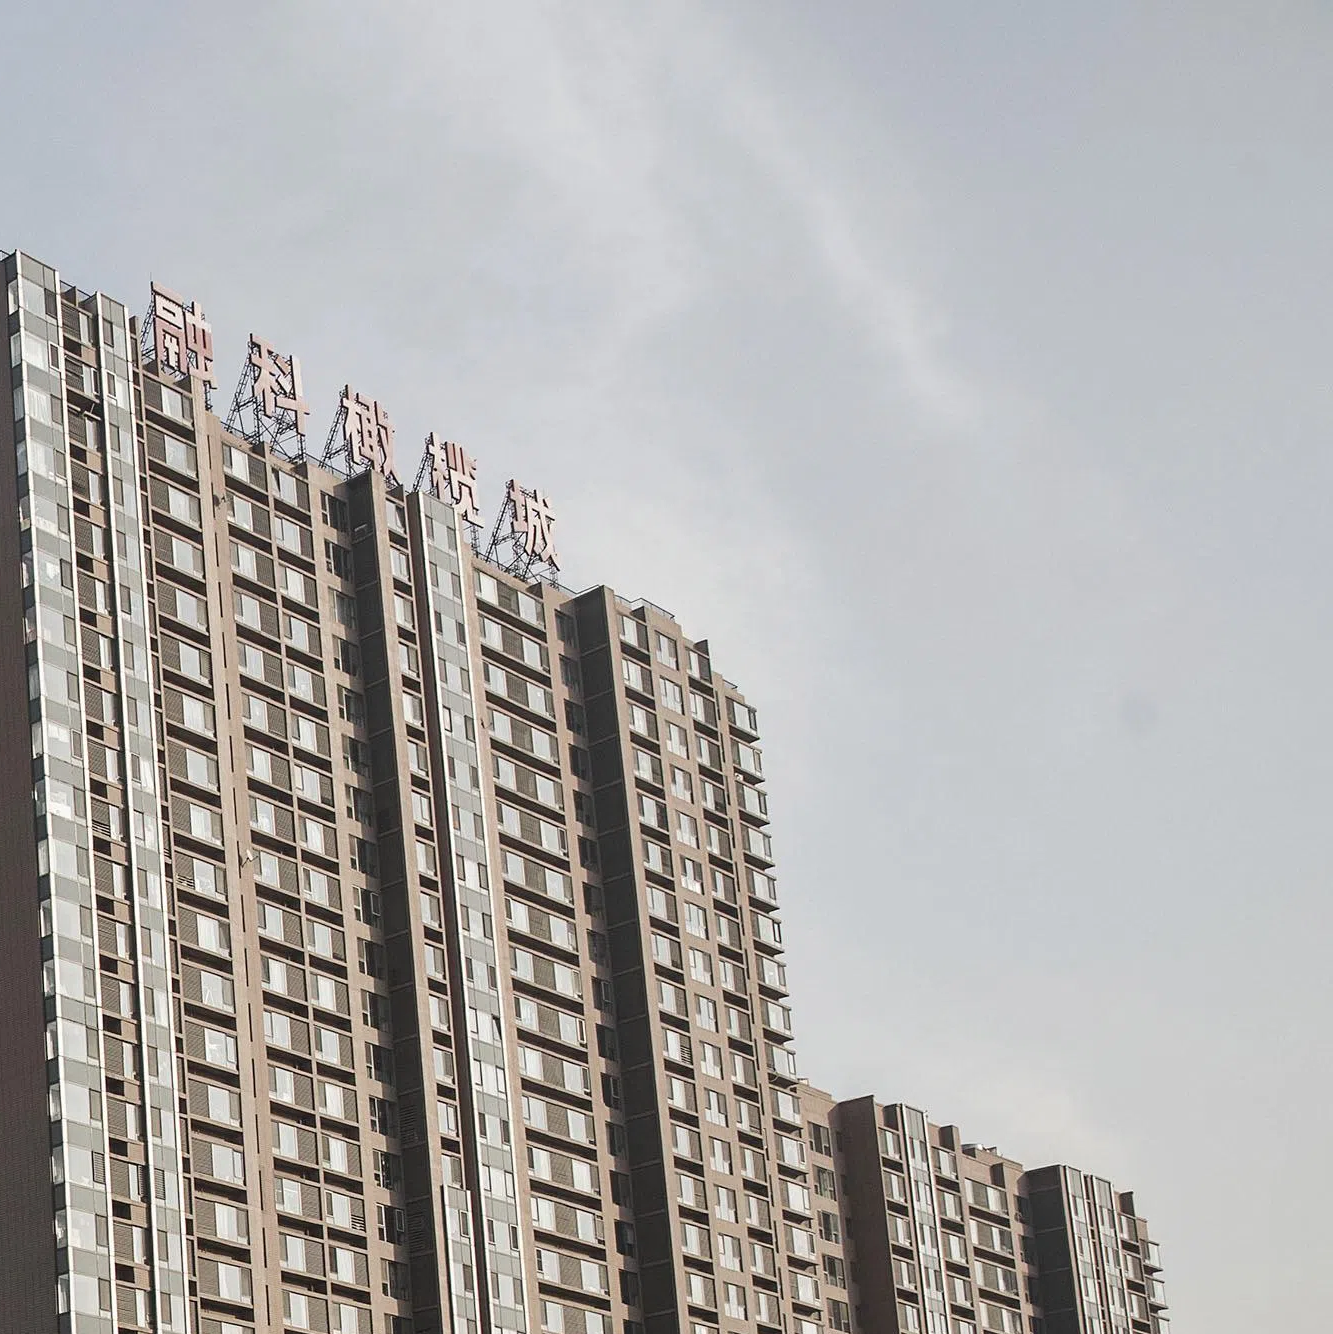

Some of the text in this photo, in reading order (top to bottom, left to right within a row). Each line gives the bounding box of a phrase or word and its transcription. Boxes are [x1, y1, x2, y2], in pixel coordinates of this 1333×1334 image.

[151, 281, 560, 572] 融科橄榄城
